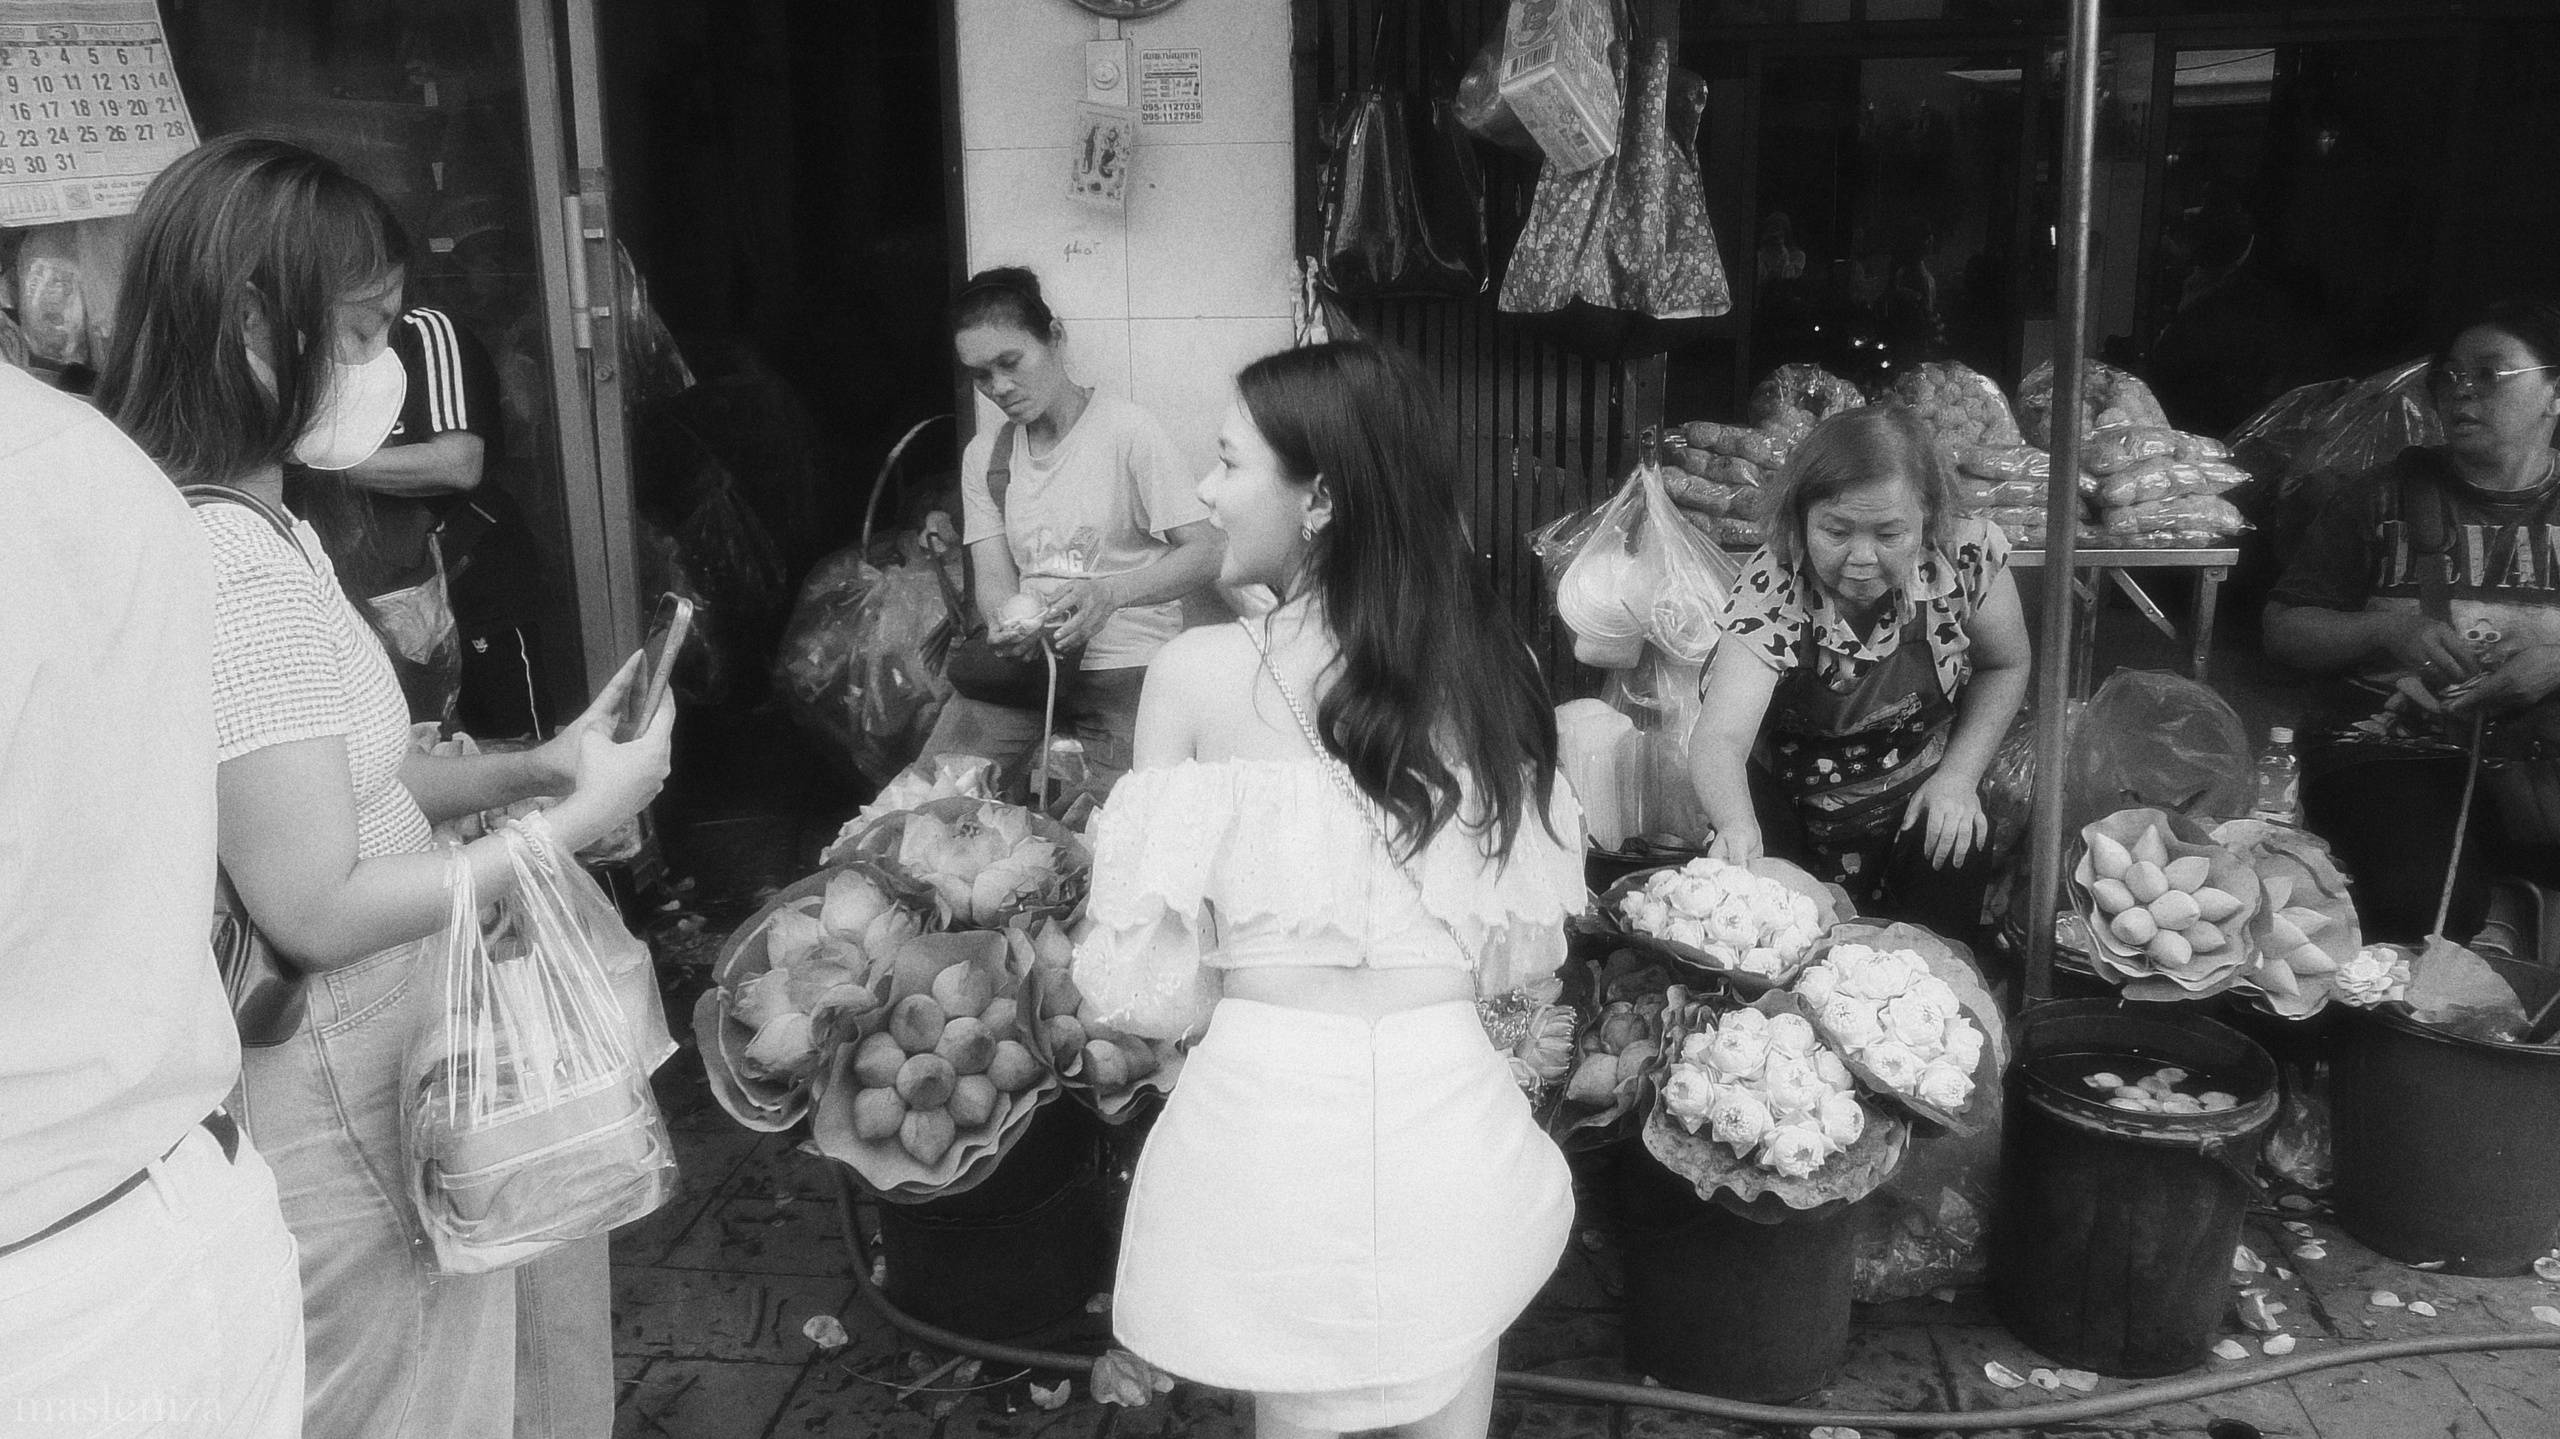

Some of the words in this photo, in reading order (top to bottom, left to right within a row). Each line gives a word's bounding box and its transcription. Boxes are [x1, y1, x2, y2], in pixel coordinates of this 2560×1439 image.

[29, 49, 40, 67] 3
[60, 48, 71, 65] 4
[88, 48, 99, 65] 5
[116, 48, 128, 66] 6
[144, 47, 154, 63] 7
[7, 75, 19, 94] 9
[33, 75, 54, 93] 10
[62, 73, 82, 91] 11
[91, 73, 112, 91] 12
[120, 73, 141, 91] 13
[148, 72, 169, 89] 14
[10, 102, 31, 121] 16
[39, 101, 60, 119] 17
[71, 99, 91, 117] 18
[99, 99, 119, 117] 19
[126, 99, 148, 116] 20
[155, 96, 177, 114] 21
[1142, 103, 1201, 112] 095-1127039
[17, 129, 39, 147] 23
[47, 127, 69, 145] 24
[77, 125, 98, 143] 25
[105, 125, 127, 142] 26
[135, 124, 154, 141] 27
[163, 121, 186, 138] 28
[24, 155, 47, 174] 30
[54, 152, 77, 171] 31
